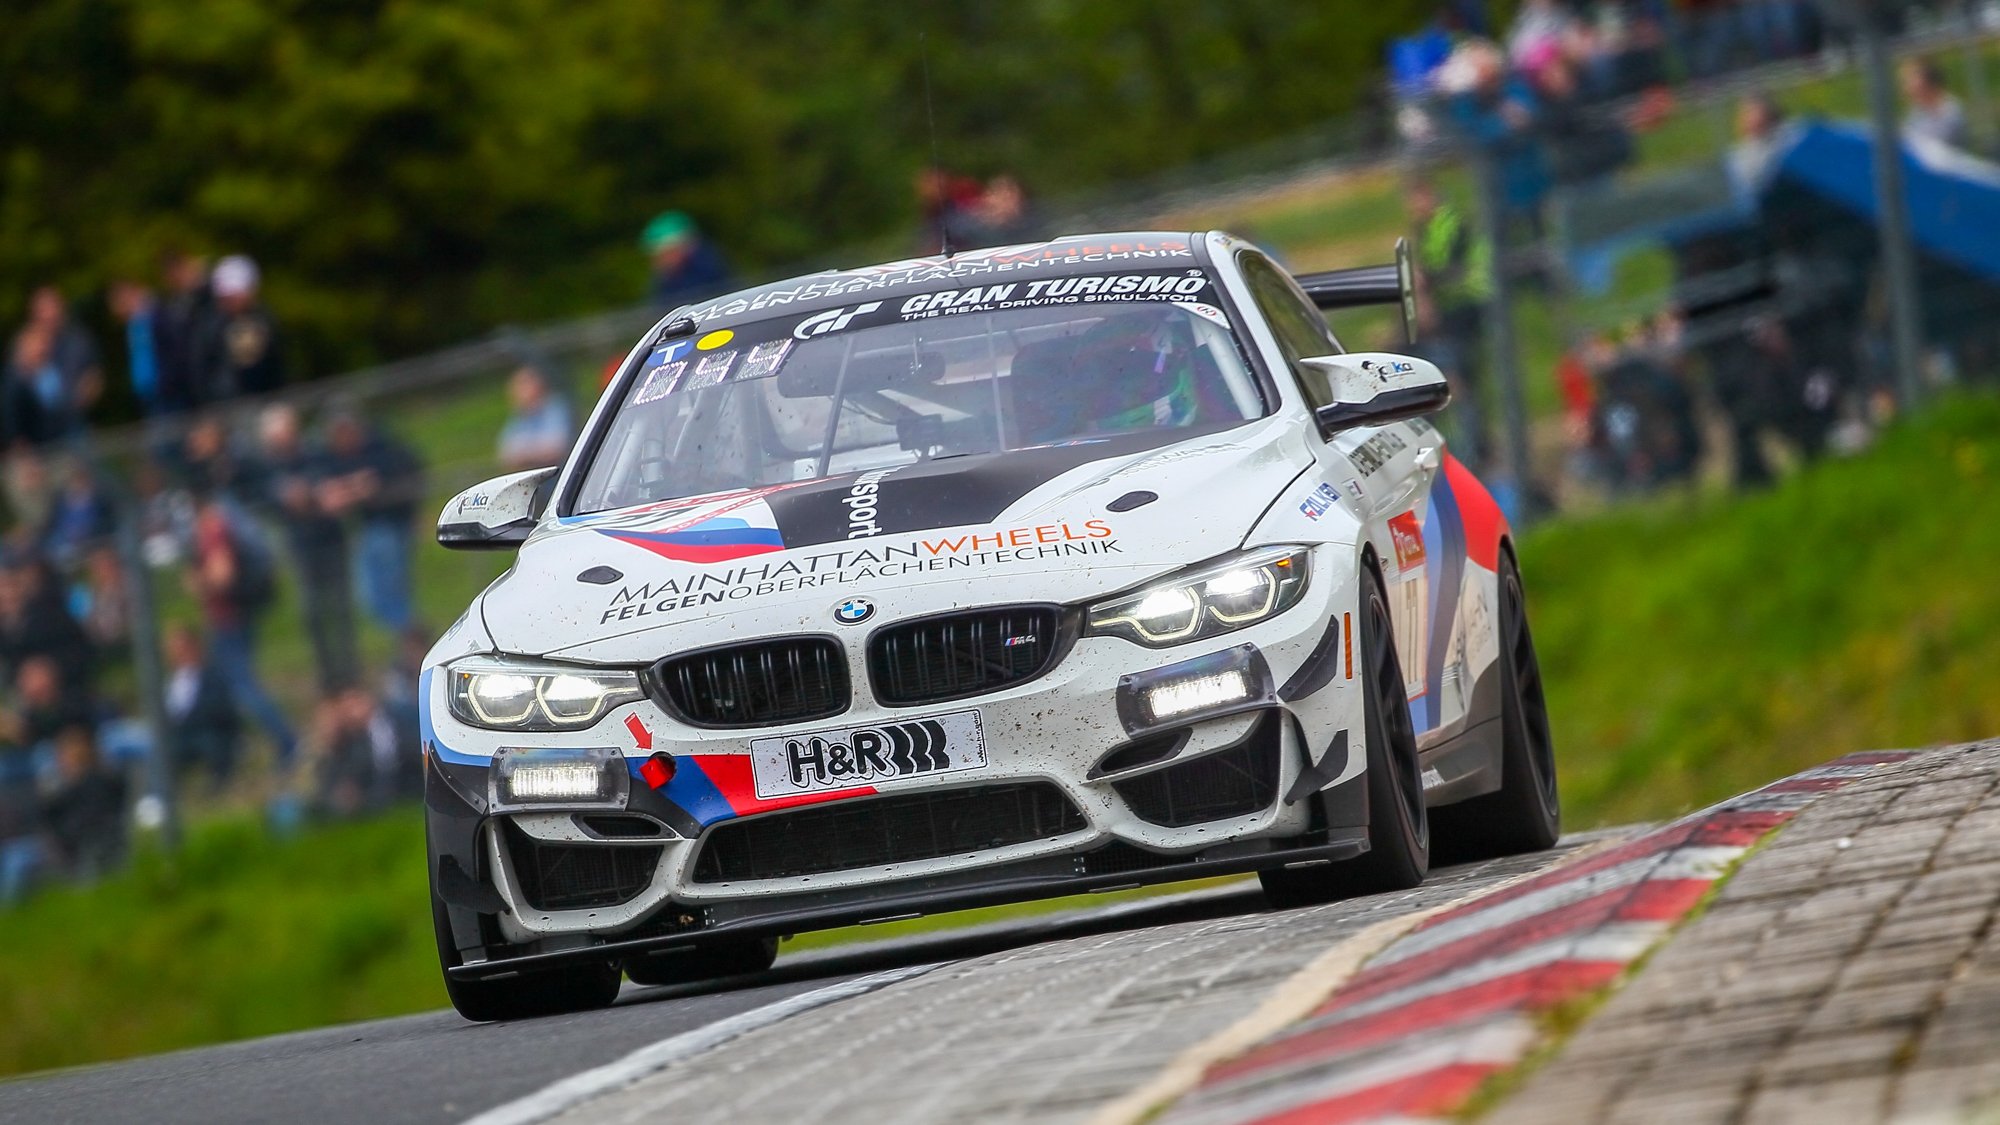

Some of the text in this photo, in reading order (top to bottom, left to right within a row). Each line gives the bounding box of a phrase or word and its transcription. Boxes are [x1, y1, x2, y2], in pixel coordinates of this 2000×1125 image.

[900, 283, 1017, 313] GRAN
[901, 293, 1197, 321] THE REAL DRIVING SIMULATOR
[657, 341, 687, 364] T
[599, 539, 1124, 625] FELGENOBERFLÄCHENTECHNIK
[608, 520, 1112, 606] MAINHATTANWHEELS
[787, 730, 889, 786] H&R
